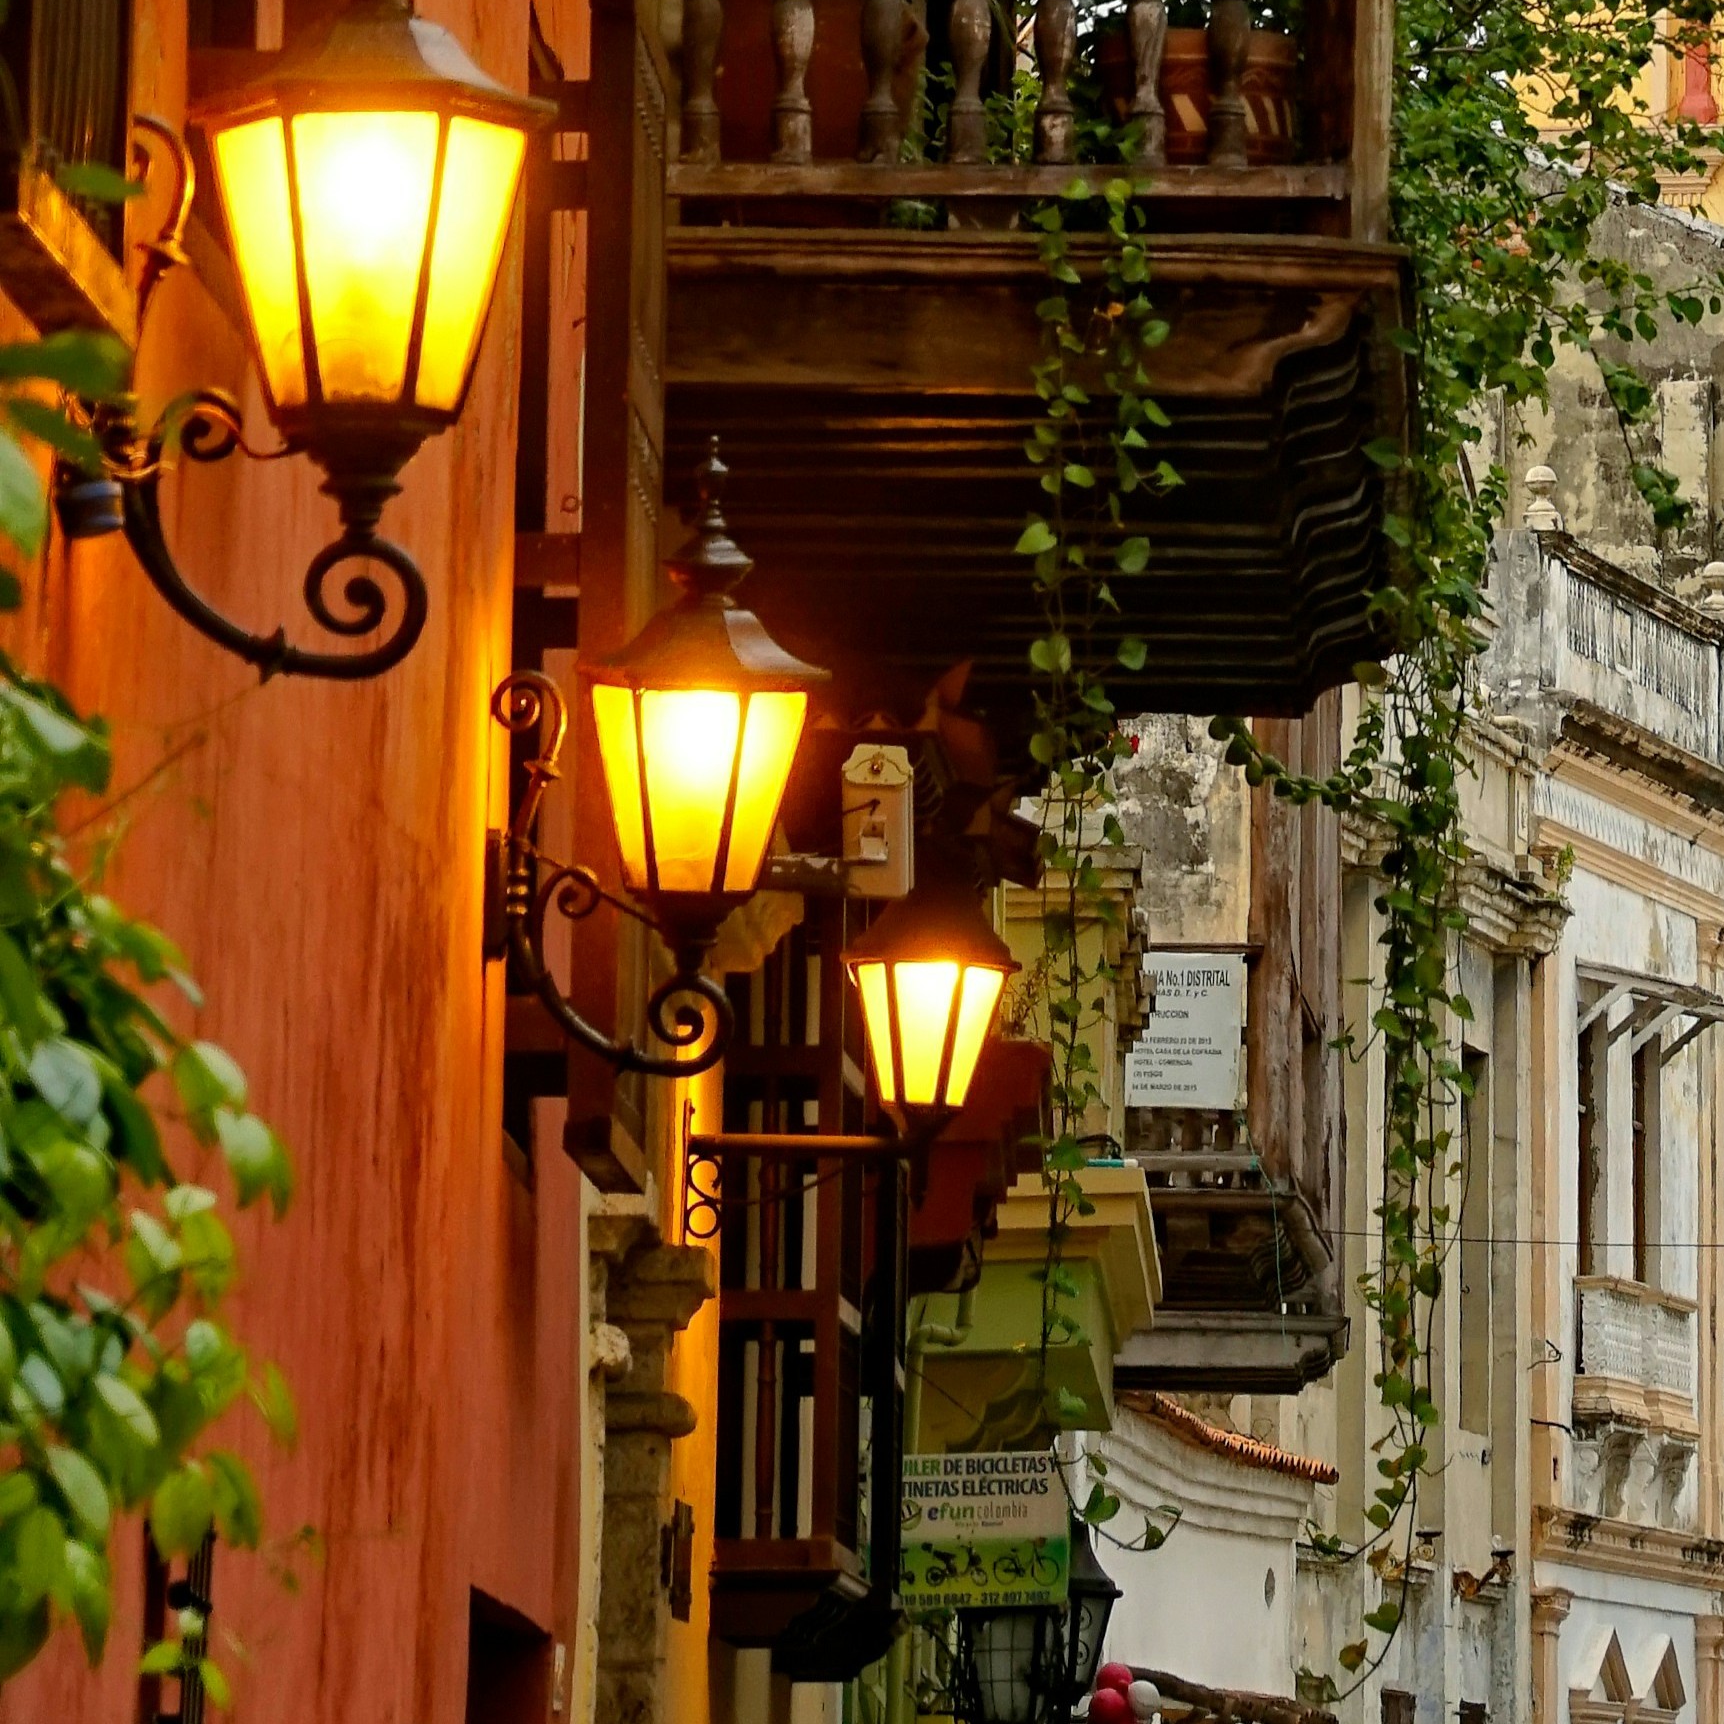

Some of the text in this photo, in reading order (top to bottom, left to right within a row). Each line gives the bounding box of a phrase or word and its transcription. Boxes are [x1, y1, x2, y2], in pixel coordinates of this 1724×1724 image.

[1187, 970, 1231, 987] DISTRITAL
[943, 1458, 962, 1475] DE
[965, 1457, 1046, 1475] BICICLETAS
[962, 1477, 1049, 1497] ELÉCTRICAS
